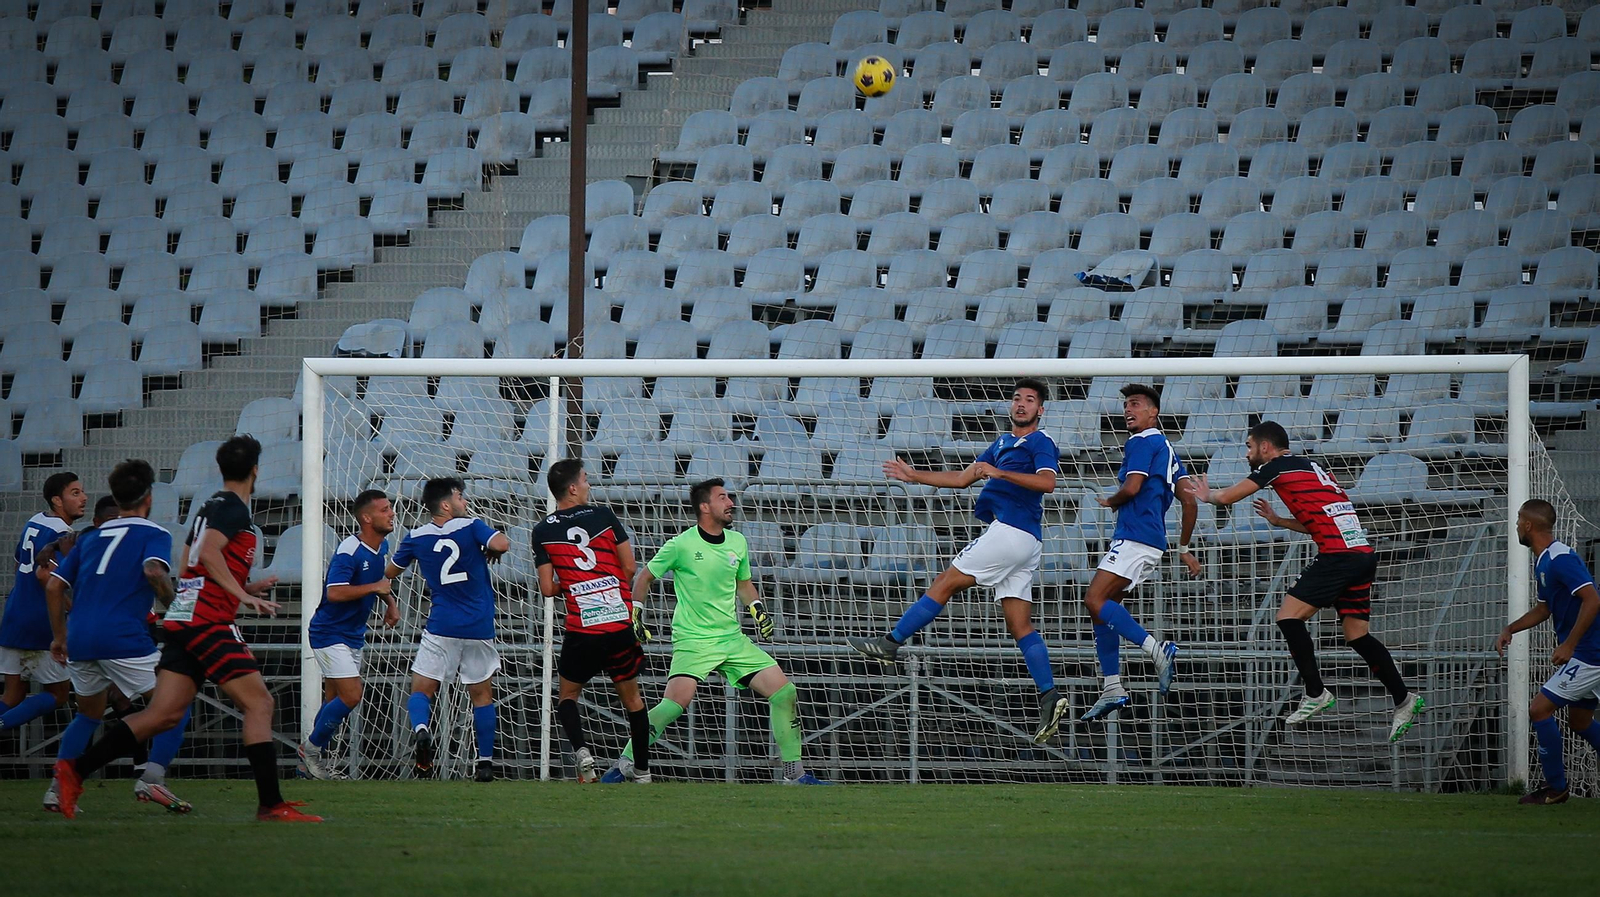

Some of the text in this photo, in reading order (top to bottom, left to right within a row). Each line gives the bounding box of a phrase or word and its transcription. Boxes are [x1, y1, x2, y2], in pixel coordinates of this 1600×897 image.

[1310, 461, 1342, 494] 4
[18, 526, 40, 574] 5
[96, 526, 130, 575] 7
[432, 538, 468, 586] 2
[566, 525, 597, 571] 3
[1558, 662, 1580, 681] 14
